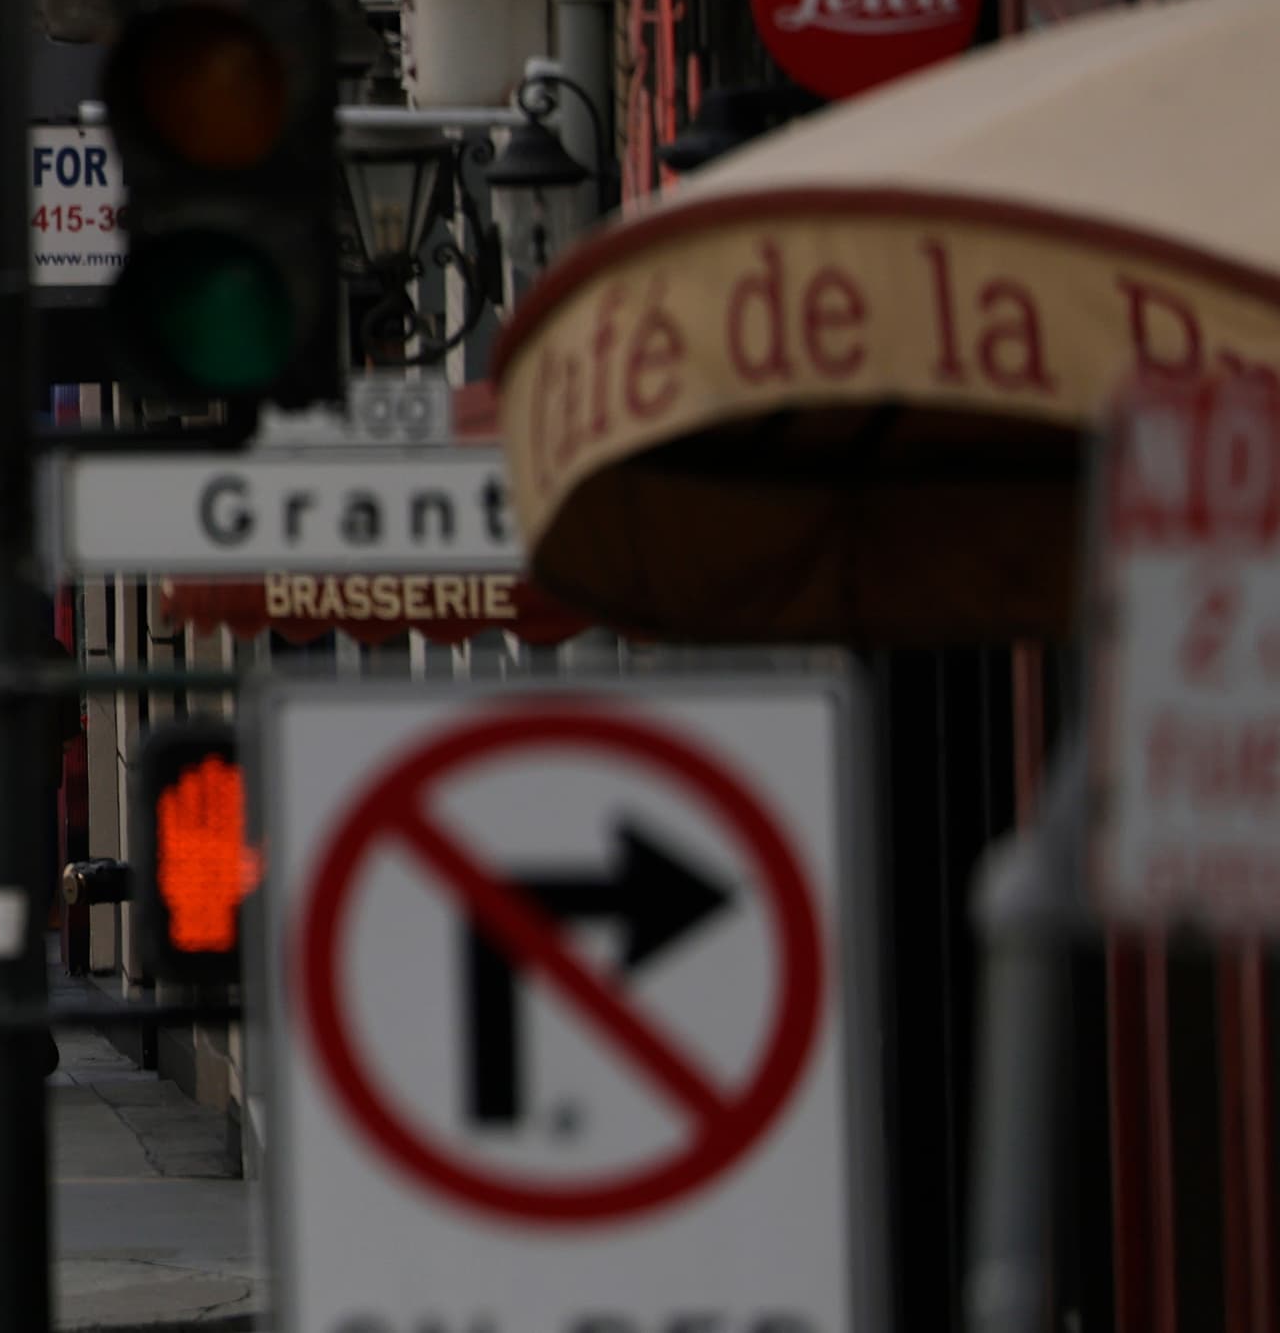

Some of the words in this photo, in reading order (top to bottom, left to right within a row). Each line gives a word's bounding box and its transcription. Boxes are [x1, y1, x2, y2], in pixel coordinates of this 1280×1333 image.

[32, 146, 108, 187] FOR
[727, 235, 867, 386] de
[919, 234, 1059, 396] la
[198, 473, 509, 549] Grant
[264, 571, 519, 620] BRASSERIE
